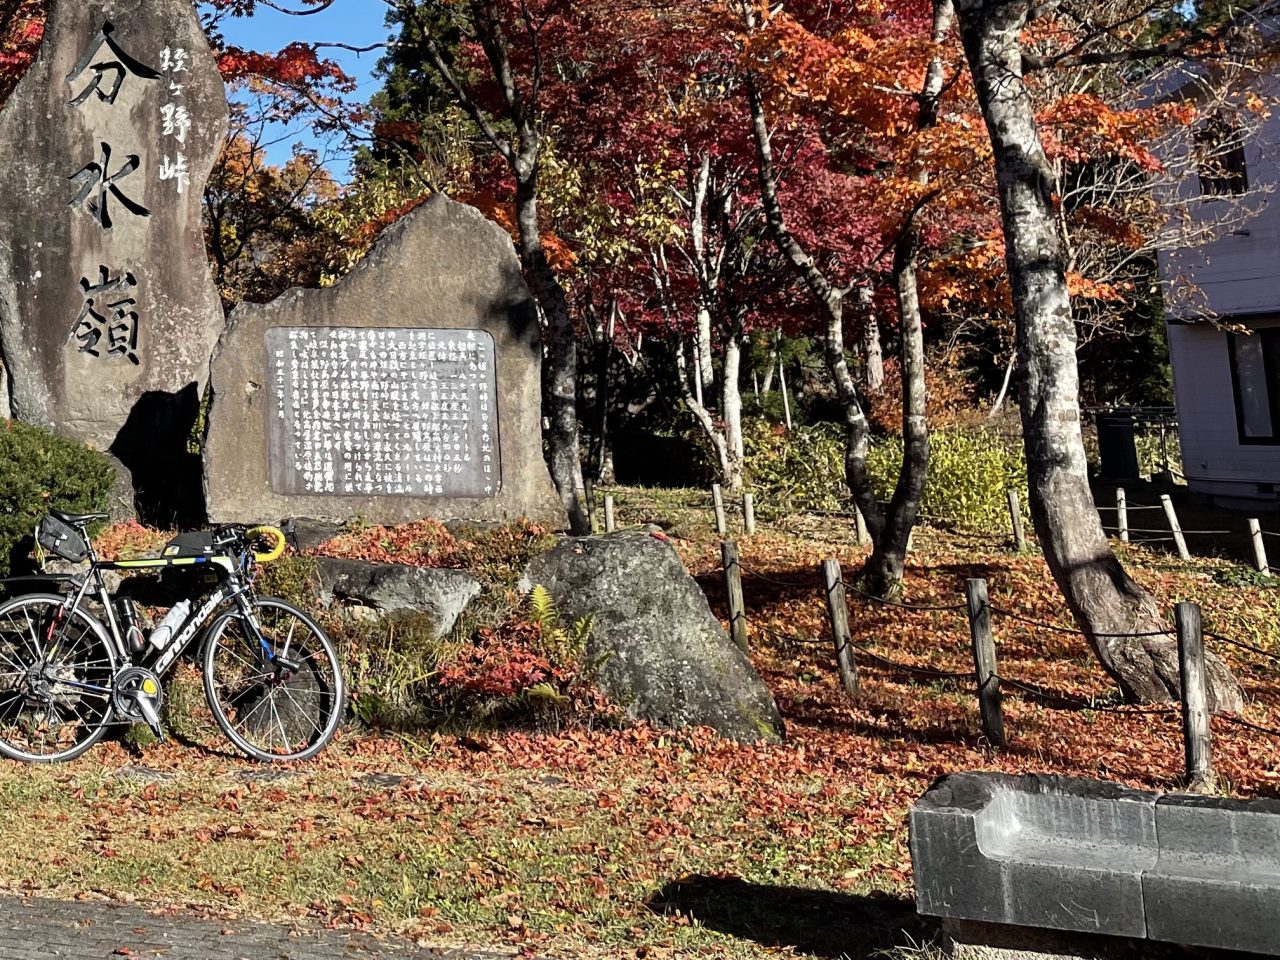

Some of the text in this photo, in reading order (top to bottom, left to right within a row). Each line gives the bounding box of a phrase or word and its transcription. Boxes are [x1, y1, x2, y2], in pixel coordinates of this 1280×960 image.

[65, 21, 161, 366] 分水嶺
[155, 589, 224, 674] cannondale
